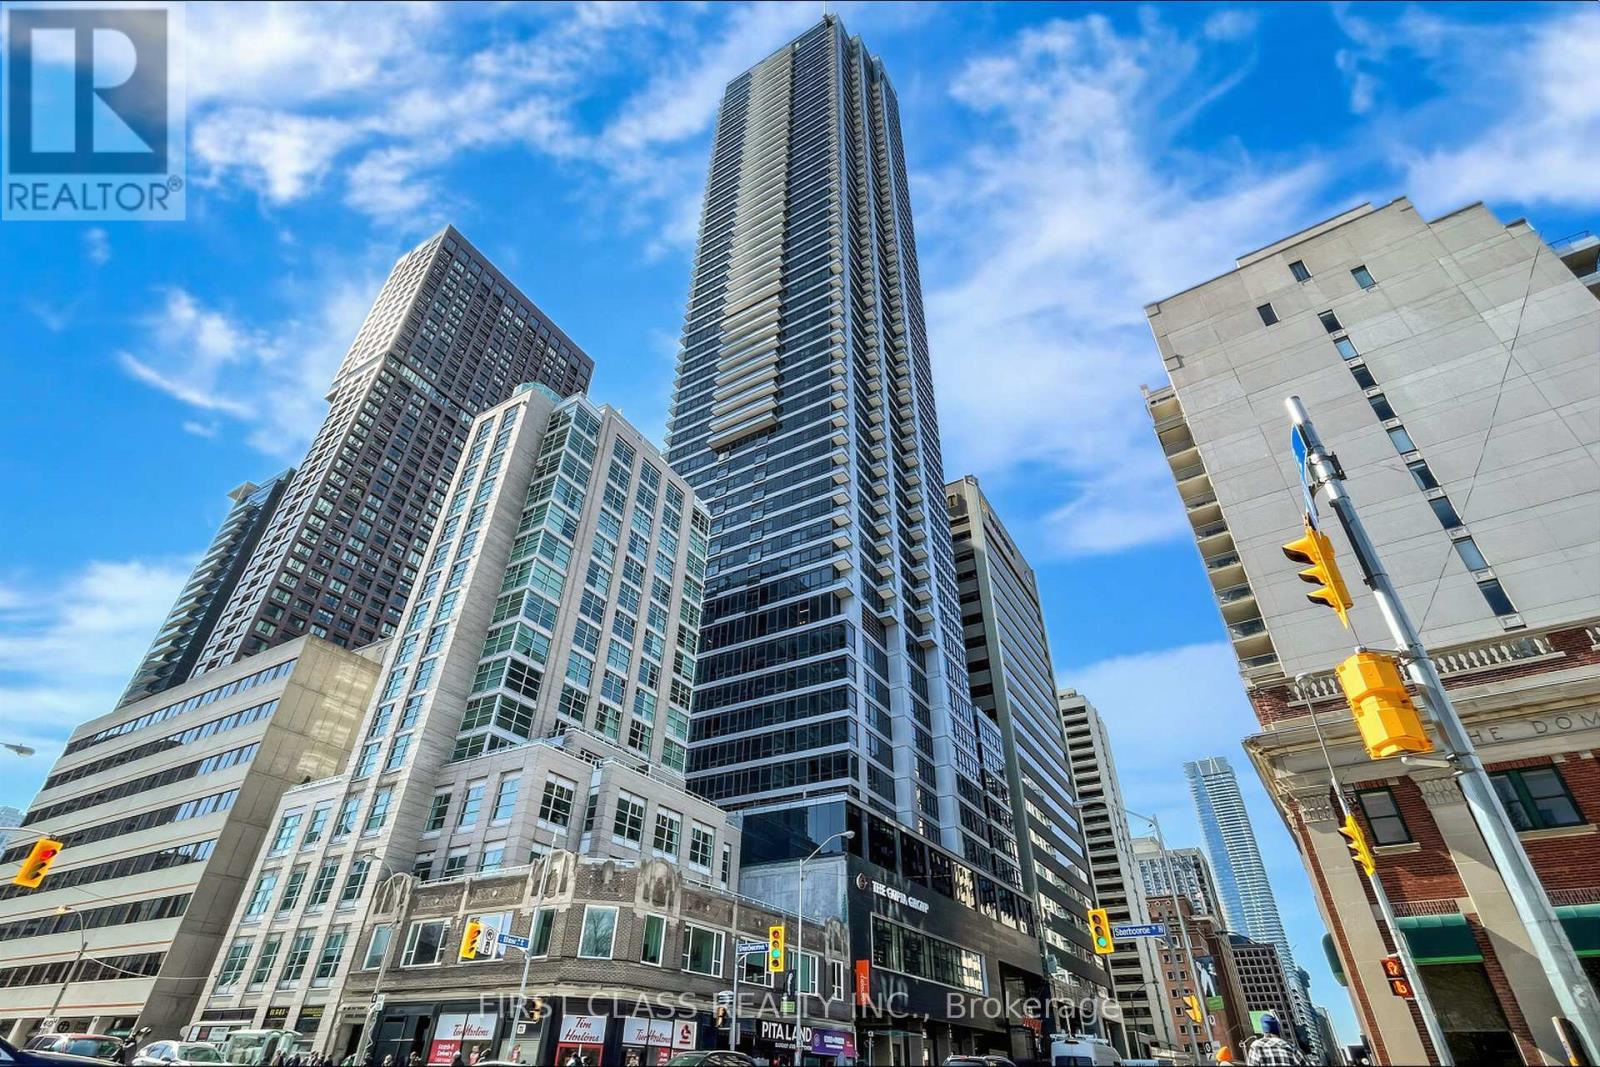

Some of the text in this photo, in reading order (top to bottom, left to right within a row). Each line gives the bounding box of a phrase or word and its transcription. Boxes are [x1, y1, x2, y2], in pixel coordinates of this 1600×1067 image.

[872, 880, 887, 897] THE
[575, 1016, 591, 1029] Tim
[761, 1020, 785, 1040] PITA
[564, 1028, 600, 1042] Hortons
